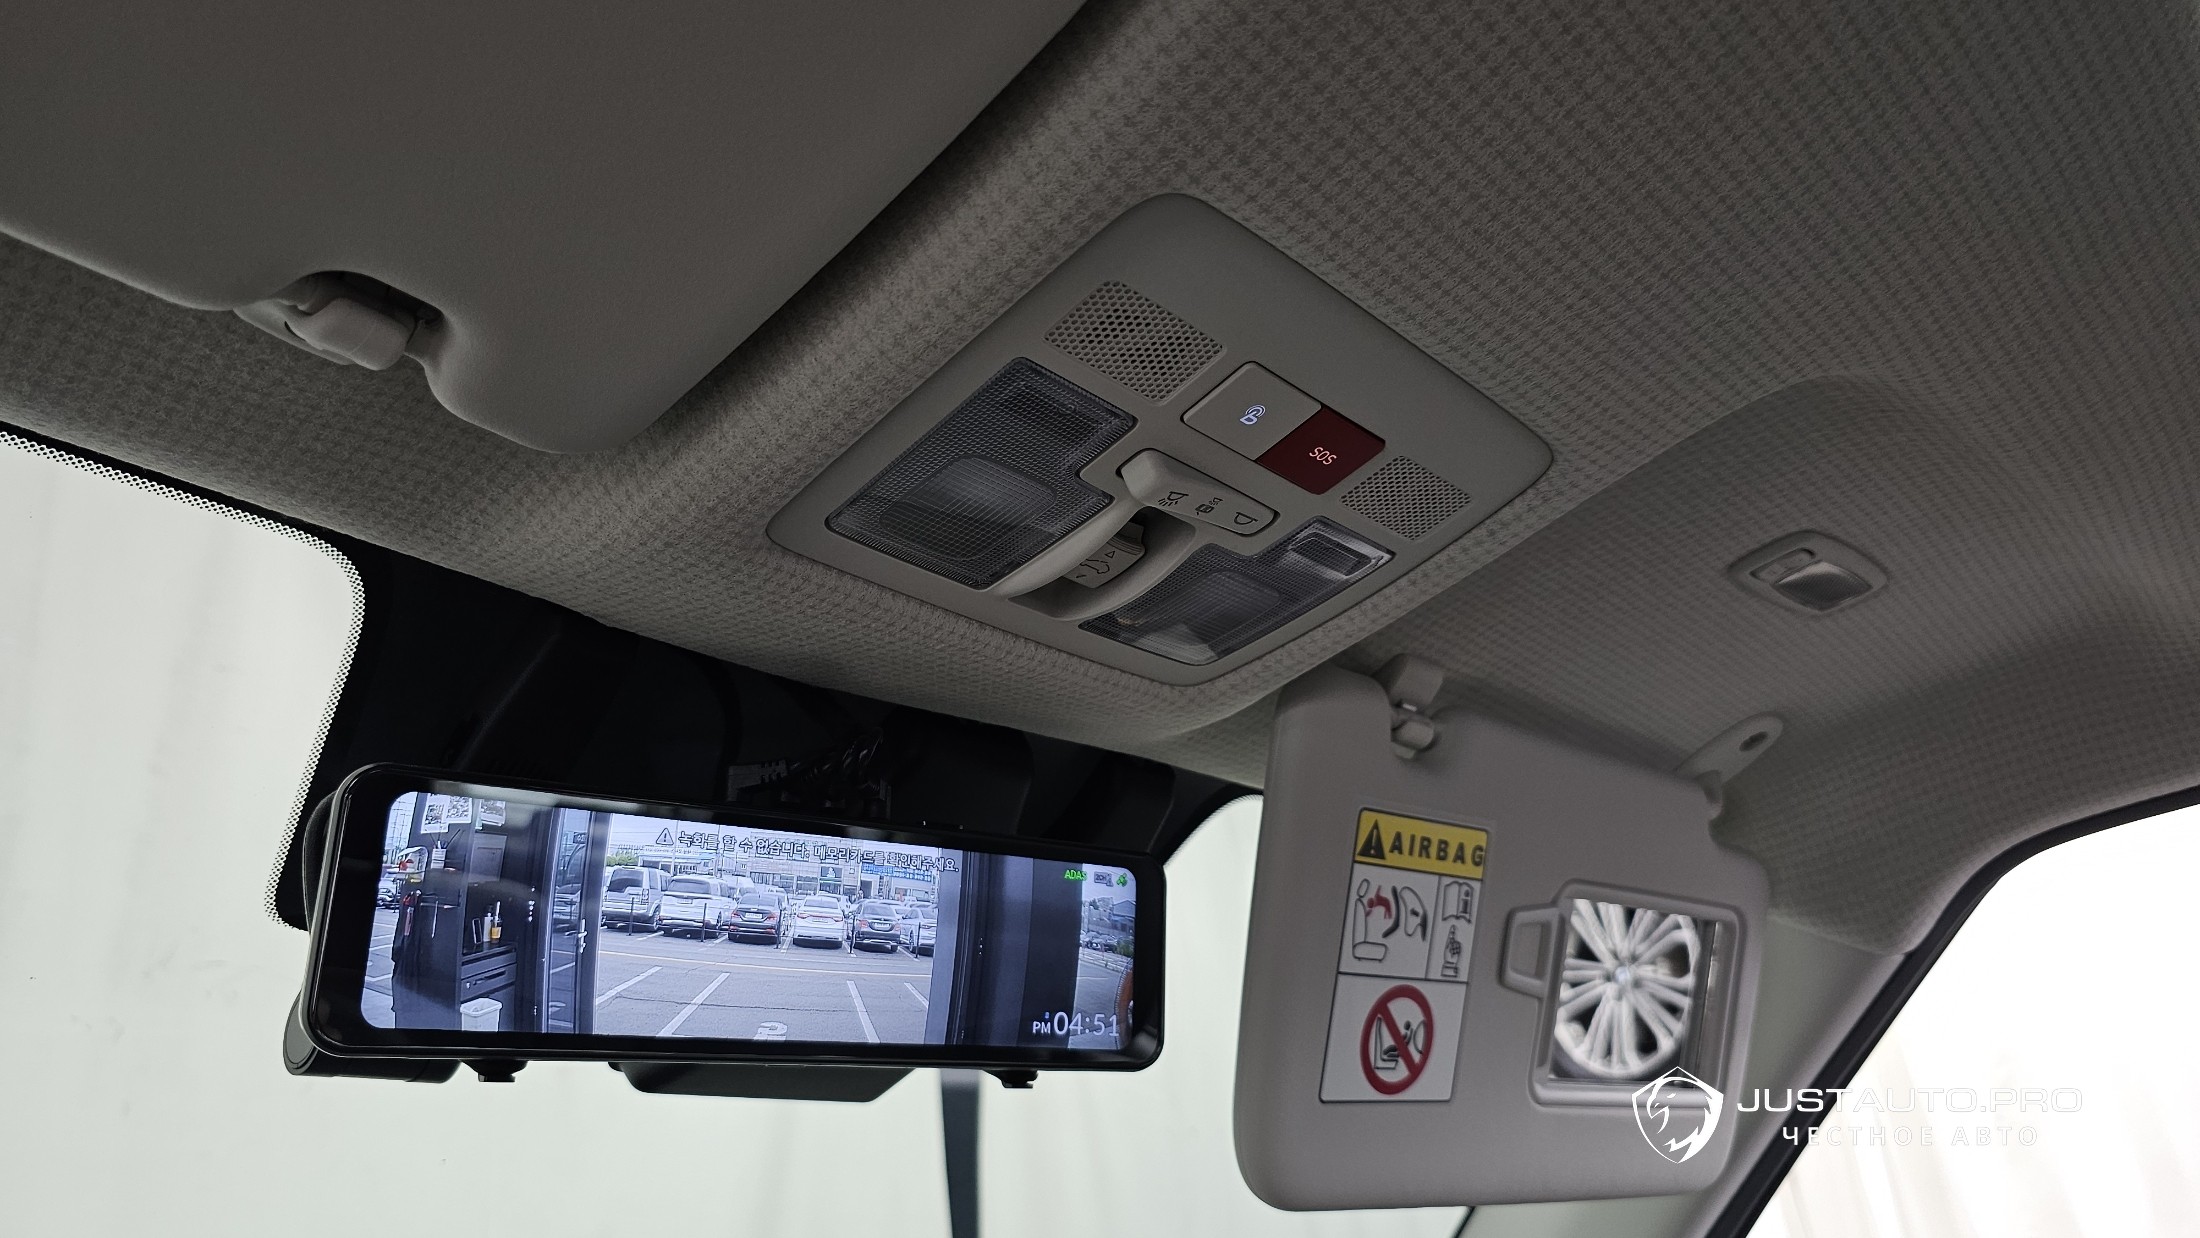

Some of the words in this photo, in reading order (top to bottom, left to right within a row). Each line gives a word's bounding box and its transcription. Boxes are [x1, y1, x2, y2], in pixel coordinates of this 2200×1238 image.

[1309, 446, 1337, 465] SOS
[678, 830, 720, 851] 녹화를
[723, 835, 737, 852] 할
[739, 837, 753, 853] 수
[814, 844, 885, 867] 메모리카드를
[1388, 830, 1485, 867] AIRBAG
[1064, 869, 1087, 880] ADAS
[1032, 1020, 1051, 1034] PM
[1053, 1011, 1120, 1037] 04:51
